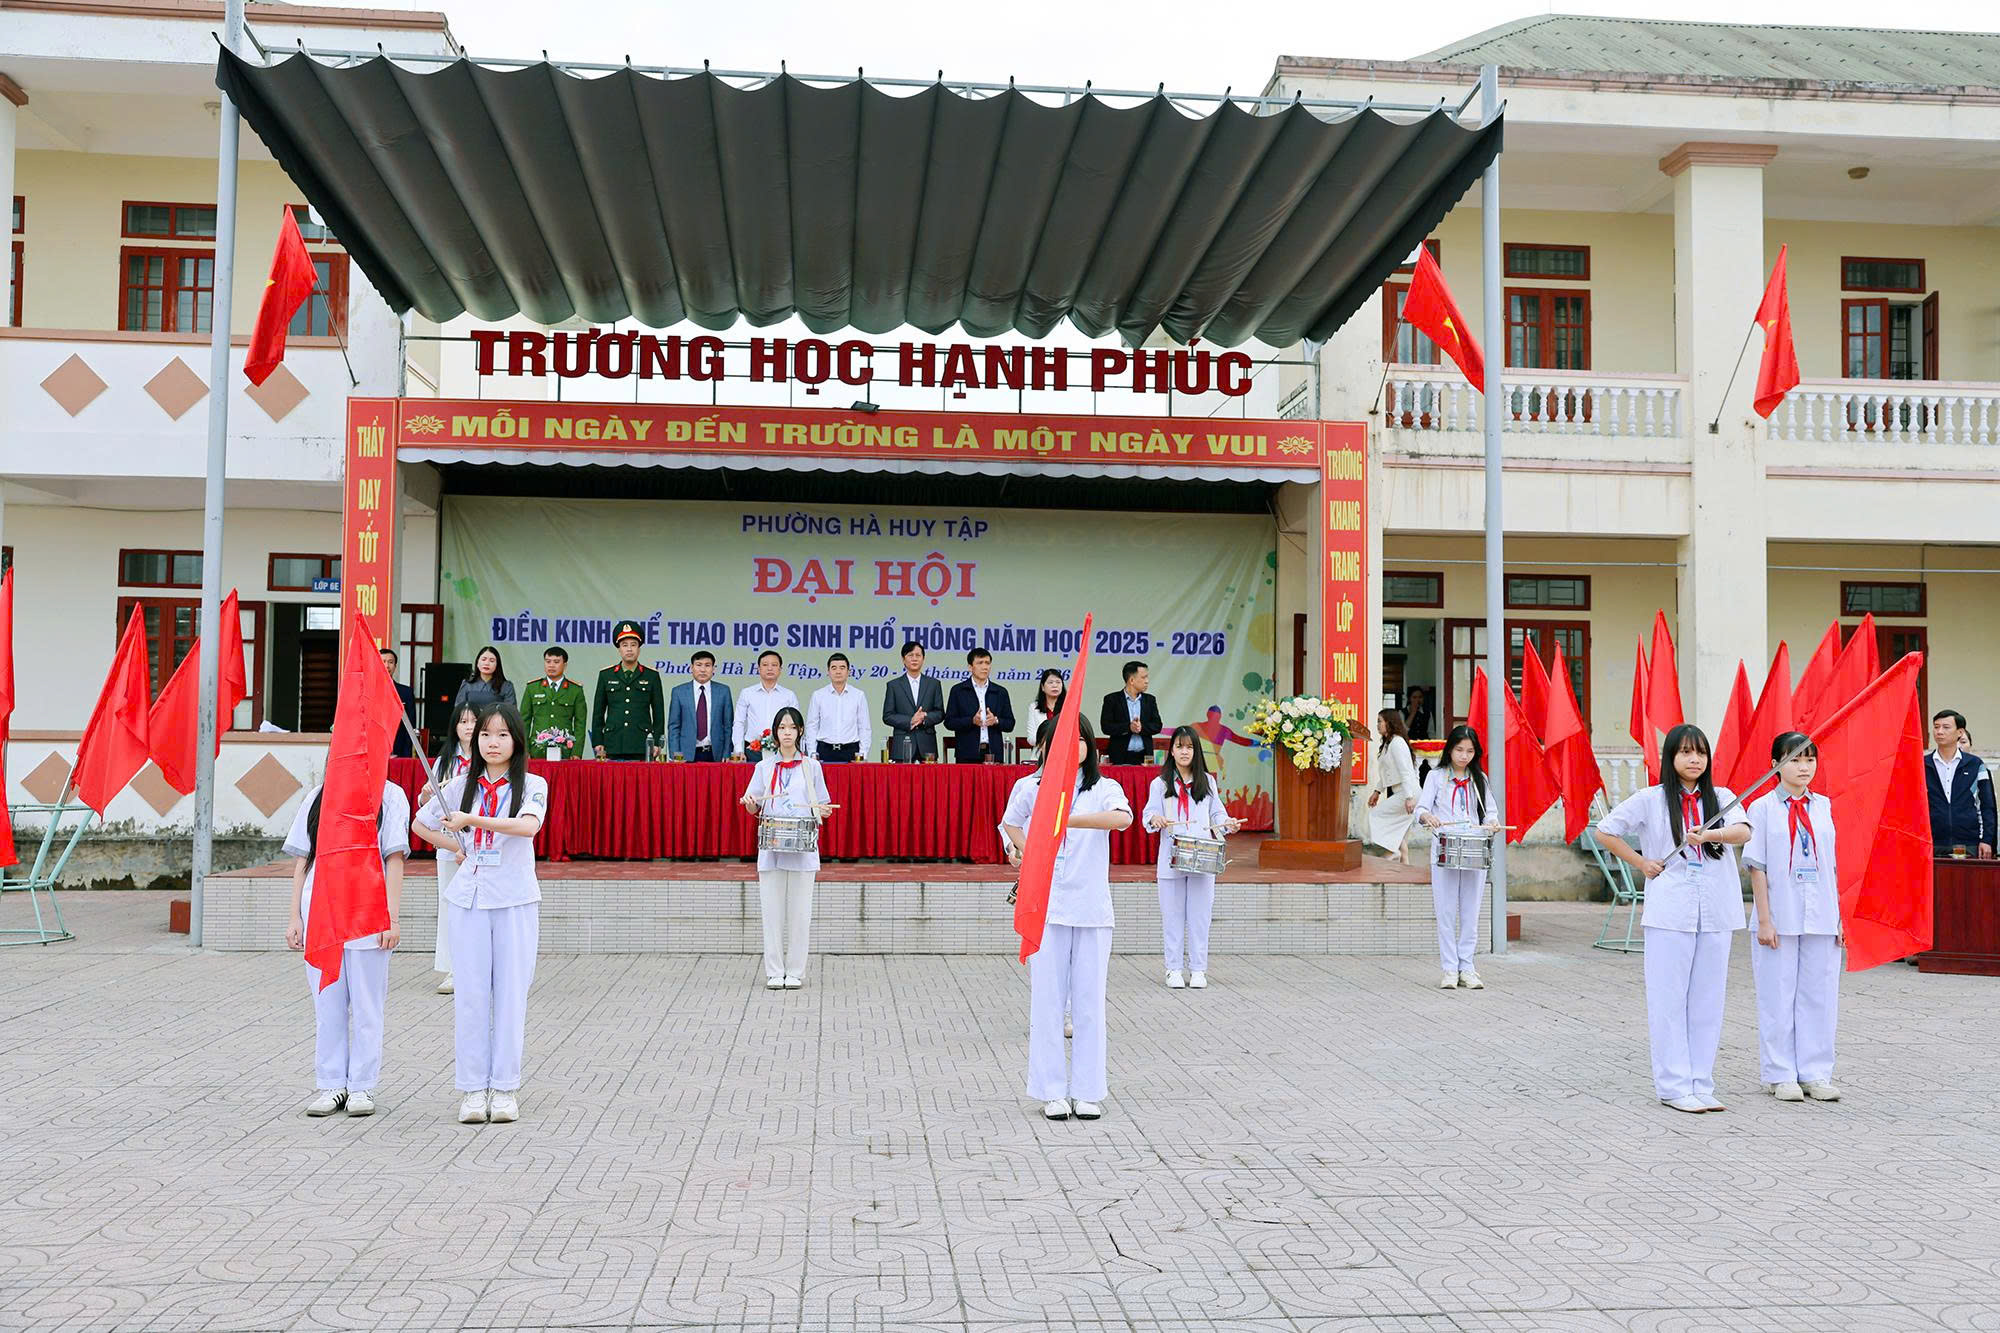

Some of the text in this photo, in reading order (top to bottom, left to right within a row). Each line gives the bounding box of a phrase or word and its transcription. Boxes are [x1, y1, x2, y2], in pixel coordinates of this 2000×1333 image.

[750, 338, 874, 395] HỌC
[899, 342, 1067, 399] HẠNH
[1092, 338, 1253, 397] PHÚC
[452, 408, 1267, 456] MỖI NGÀY ĐẾN TRƯỜNG LÀ MỘT NGÀY VUI
[1327, 443, 1362, 480] TRƯỜNG
[358, 479, 381, 517] DẠY
[1329, 501, 1360, 530] KHANG
[358, 520, 379, 563] TỐT
[742, 511, 988, 541] PHƯỜNG HÀ HUY TẬP
[753, 552, 976, 605] ĐẠI HỘI
[1330, 551, 1360, 581] TRANG
[355, 576, 377, 616] TRÒ
[1336, 592, 1353, 632] LỚP
[493, 611, 547, 643] ĐIỀN
[556, 620, 611, 643] KINH
[668, 621, 729, 646] THAO
[734, 623, 779, 651] HỌC
[787, 624, 841, 649] SINH
[851, 617, 896, 650] PHỔ
[902, 622, 976, 652] THÔNG
[984, 624, 1035, 653] NĂM
[1095, 631, 1149, 654] 2025
[1172, 632, 1225, 655] 2026
[722, 662, 743, 675] Hà
[788, 663, 821, 679] Tập,
[870, 666, 888, 678] 20
[997, 668, 1031, 681] năm
[1333, 646, 1357, 683] THÂN
